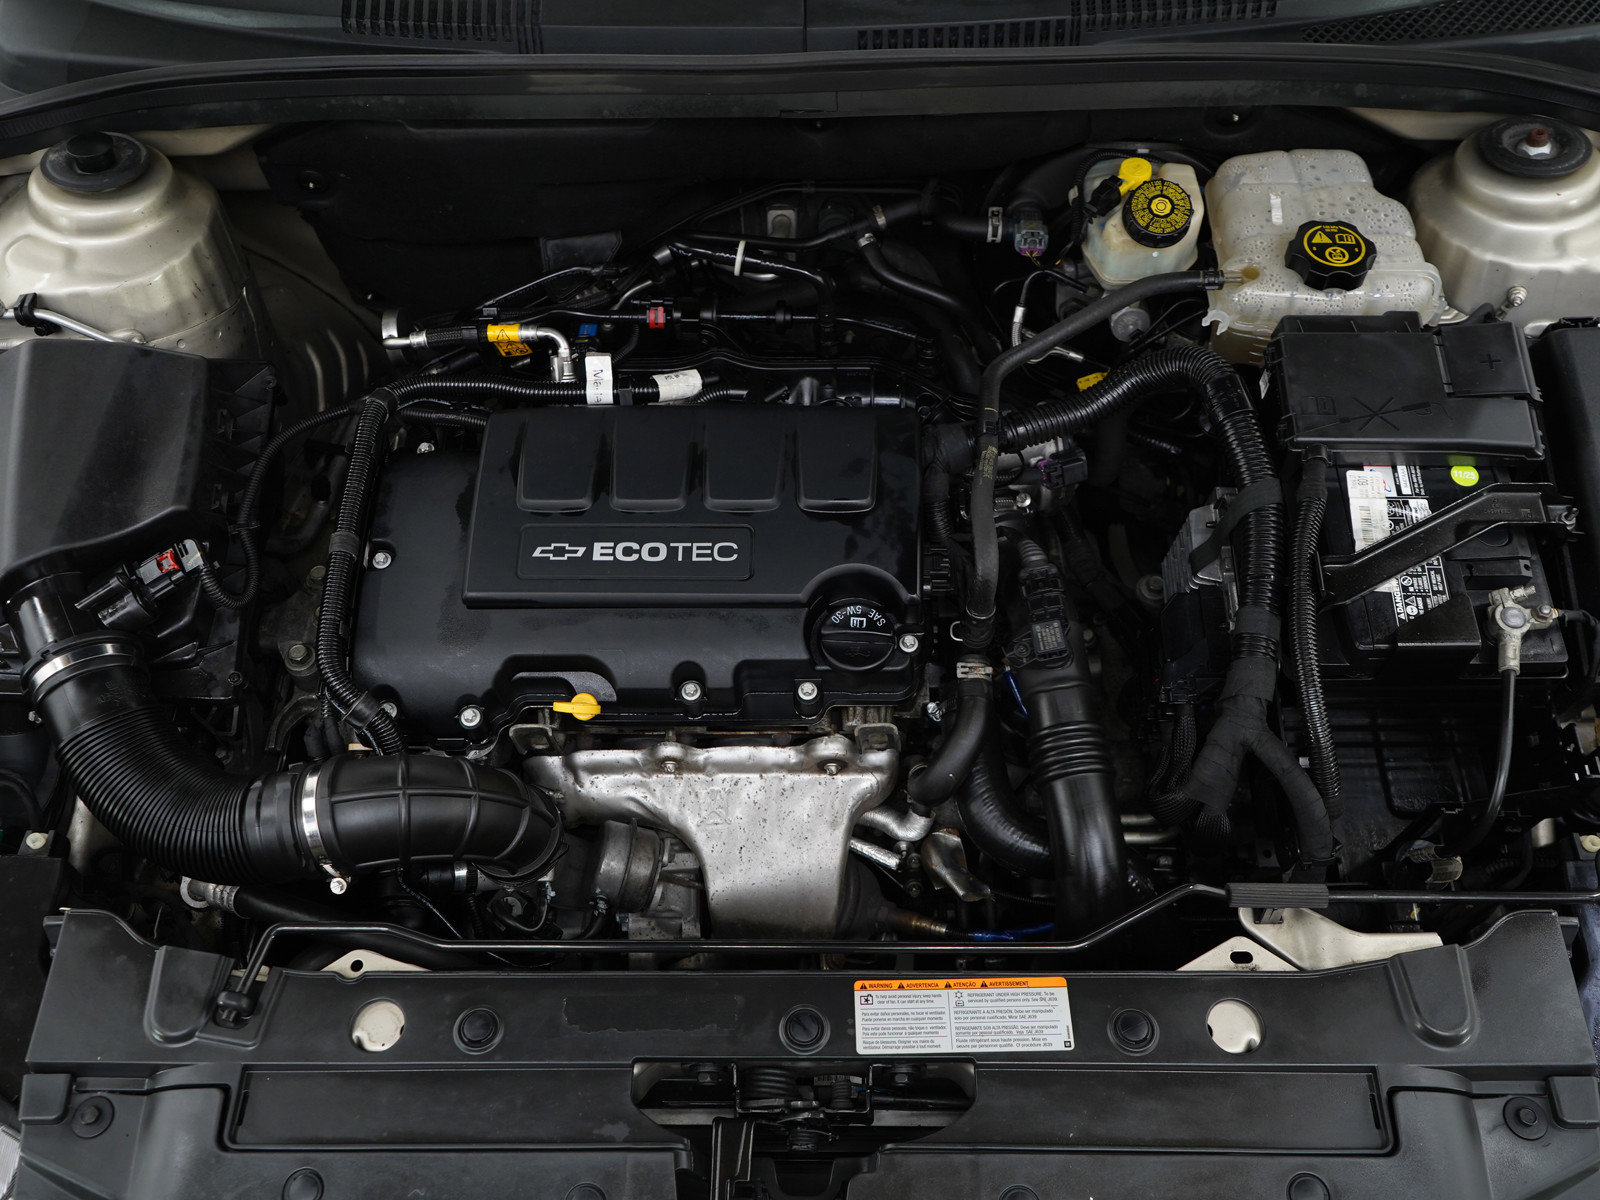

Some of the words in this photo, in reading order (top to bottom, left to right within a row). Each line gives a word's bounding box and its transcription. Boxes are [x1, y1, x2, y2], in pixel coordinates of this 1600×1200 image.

[592, 541, 738, 562] ECOTEC
[831, 605, 862, 624] 5W-30
[868, 608, 886, 627] SAE
